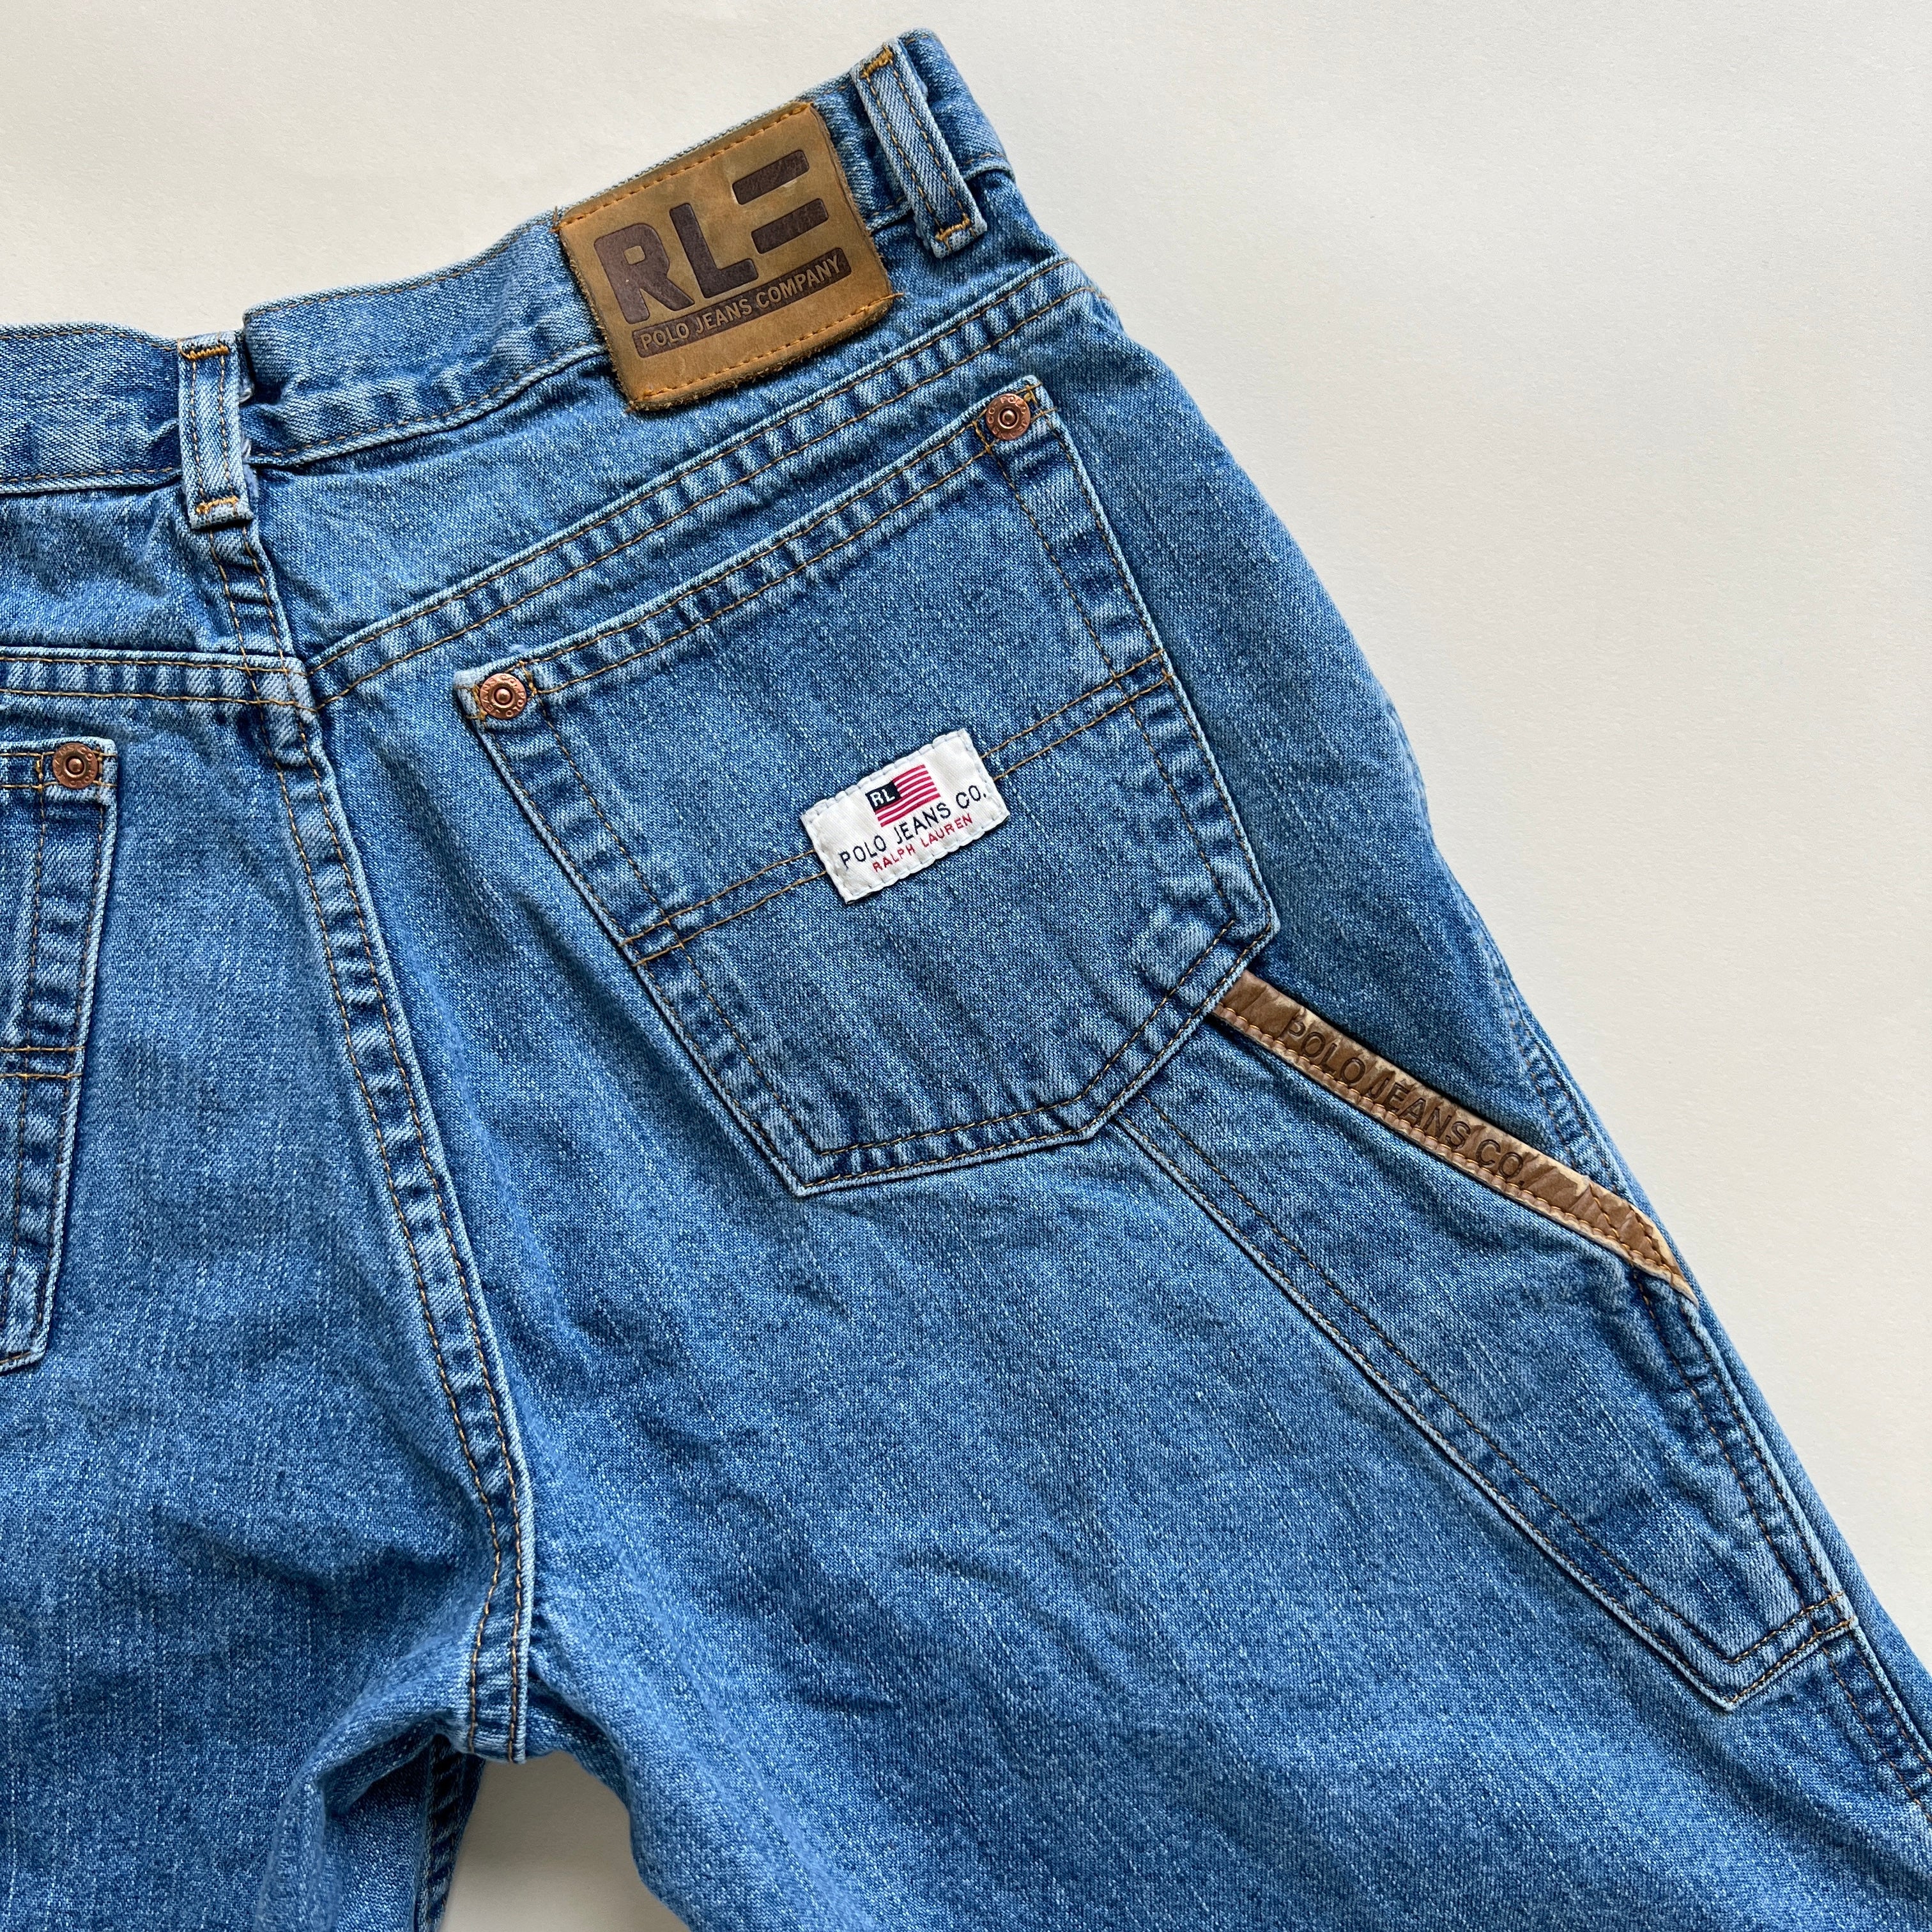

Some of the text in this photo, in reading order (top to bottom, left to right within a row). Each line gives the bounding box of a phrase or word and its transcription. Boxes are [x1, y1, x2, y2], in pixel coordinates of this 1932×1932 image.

[640, 254, 842, 351] POLO JEANS COMPANY
[838, 785, 986, 870] POLO JEANS CO.
[869, 788, 896, 808] RL
[872, 813, 973, 873] RALPH LAUREN
[1280, 1022, 1366, 1084] POLO
[1368, 1078, 1471, 1149] JEANS
